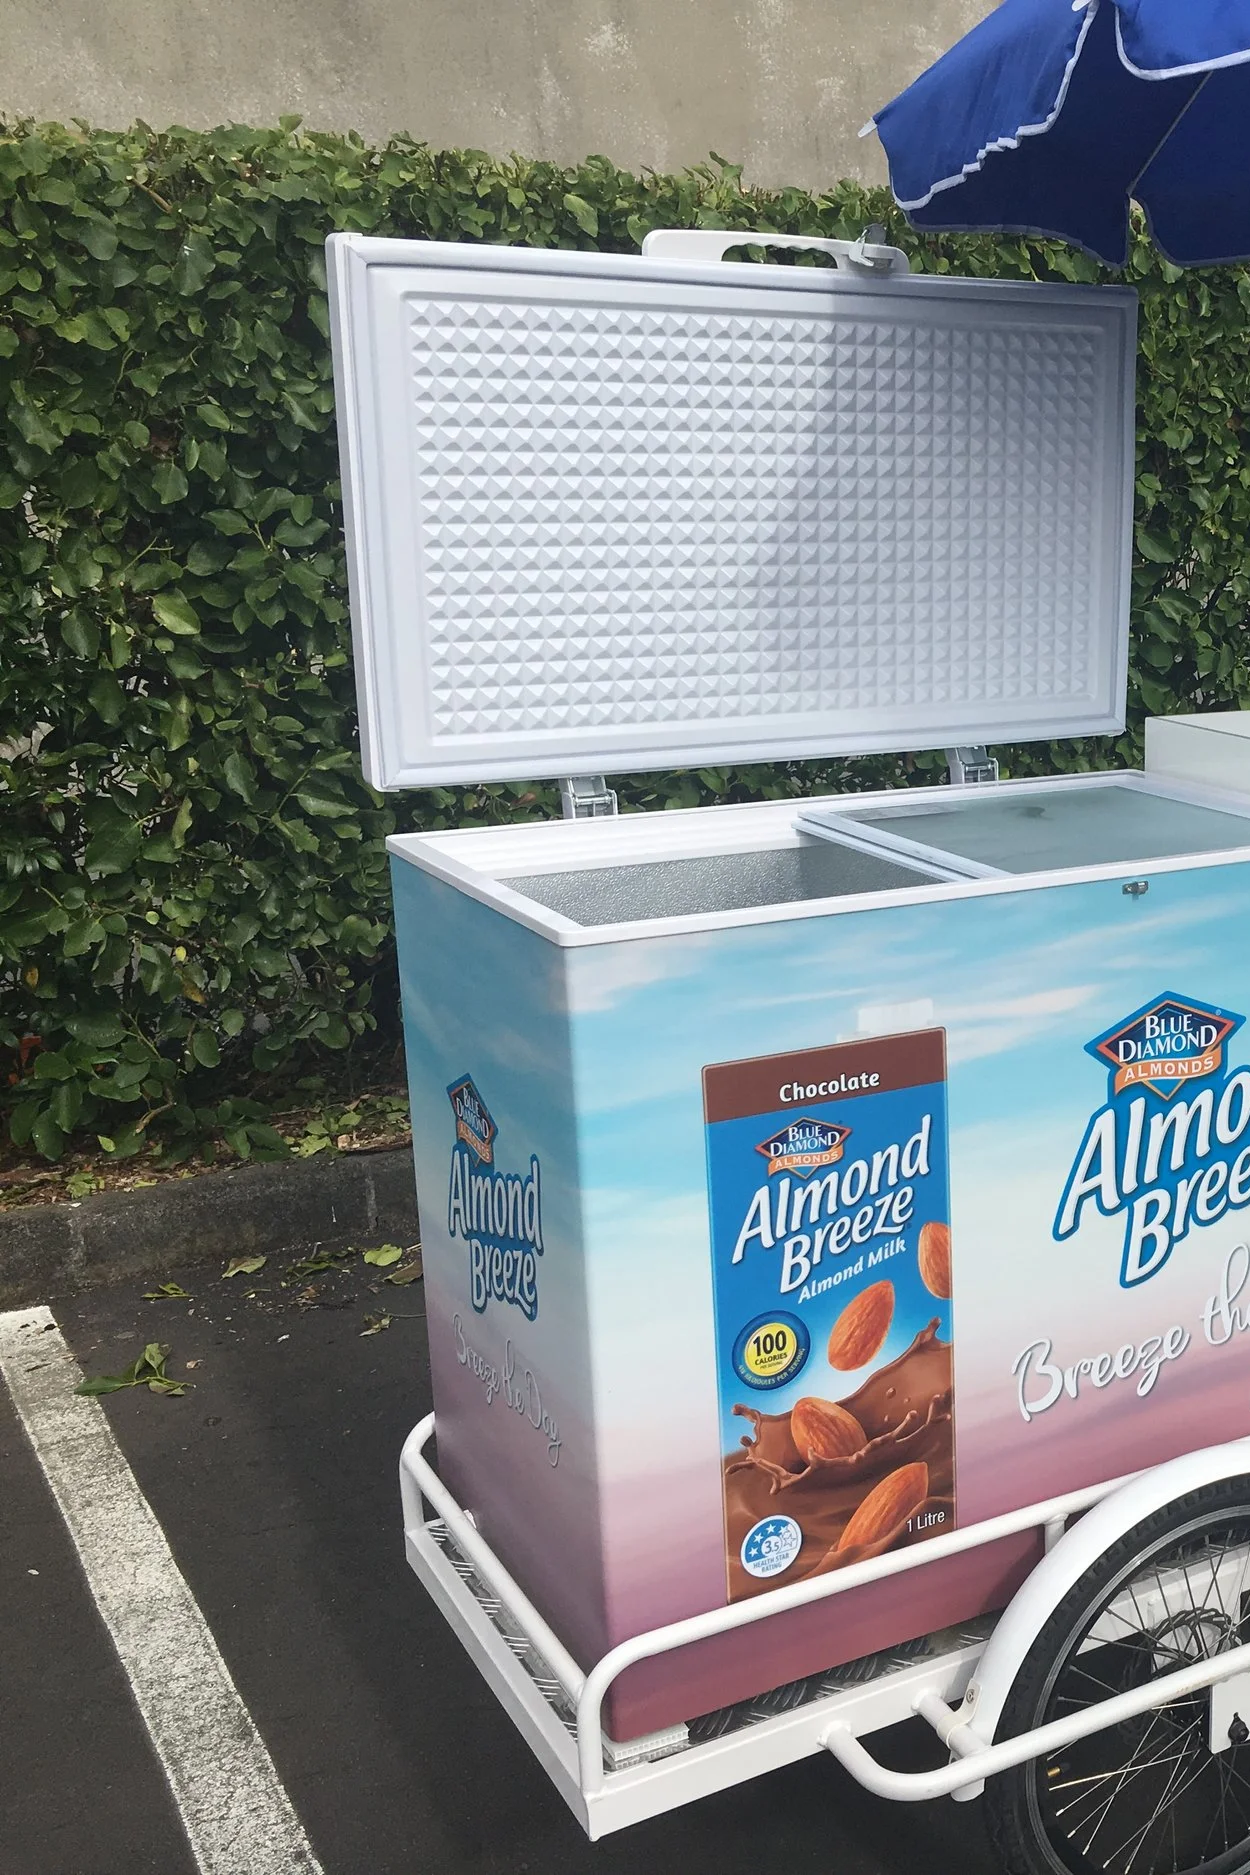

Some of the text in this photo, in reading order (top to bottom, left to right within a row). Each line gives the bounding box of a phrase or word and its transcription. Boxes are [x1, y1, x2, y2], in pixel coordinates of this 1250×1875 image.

[1145, 1014, 1194, 1039] BLUE
[1118, 1025, 1218, 1063] DIAMOND
[1124, 1056, 1215, 1082] ALMONDS
[779, 1071, 881, 1102] Chocolate
[463, 1087, 480, 1117] BLUE
[770, 1131, 841, 1157] DIAMOND
[788, 1125, 823, 1142] BLUE
[775, 1152, 839, 1169] ALMONDS
[449, 1149, 543, 1251] Almond
[731, 1113, 932, 1265] Almond
[779, 1185, 915, 1294] Breeze
[470, 1238, 536, 1315] Breeze
[797, 1237, 907, 1304] Almond Milk
[753, 1330, 787, 1357] 100
[754, 1352, 788, 1366] CALORIES
[1011, 1324, 1191, 1422] Breeze
[502, 1338, 525, 1415] the
[525, 1368, 562, 1468] Day
[906, 1510, 946, 1533] 1 Litre
[752, 1552, 790, 1569] HEALTH STAR
[764, 1540, 780, 1555] 3.5
[761, 1562, 783, 1573] RATING
